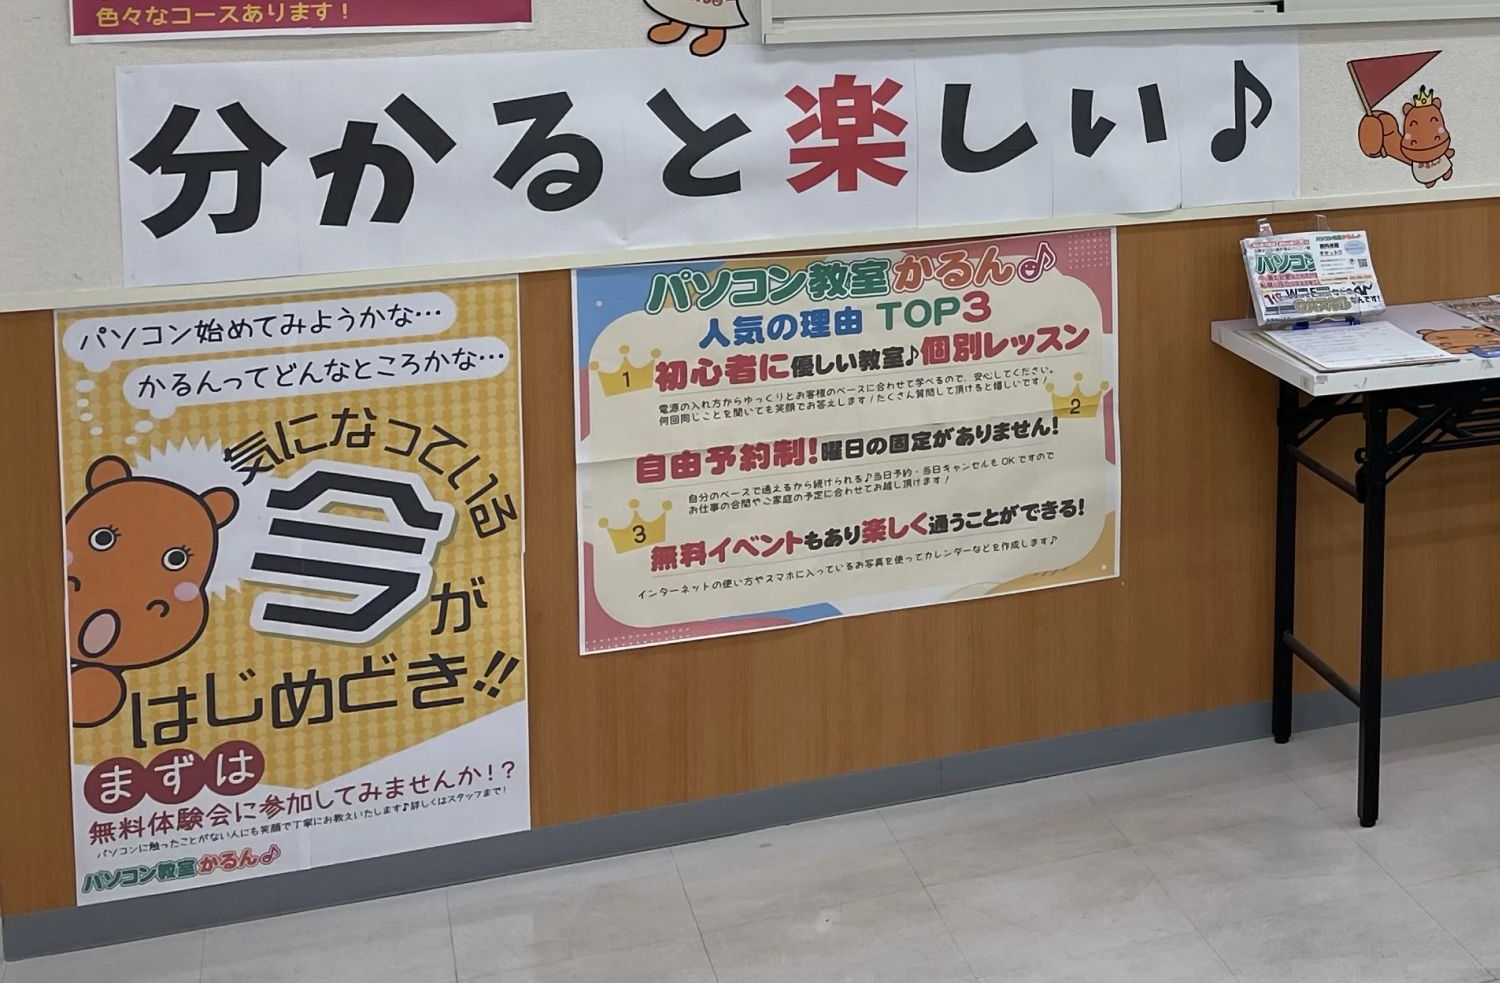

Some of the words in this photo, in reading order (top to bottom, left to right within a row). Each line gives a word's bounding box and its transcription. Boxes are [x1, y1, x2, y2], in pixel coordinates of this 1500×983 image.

[96, 2, 349, 28] 色々なコースあります！
[699, 305, 863, 349] 人気の理由
[876, 291, 992, 331] TOP3
[621, 371, 632, 389] 1
[1069, 398, 1081, 415] 2
[223, 407, 519, 540] 気になっている
[250, 469, 445, 633] 今
[632, 524, 647, 543] 3
[430, 575, 488, 636] が
[99, 748, 258, 805] まずは
